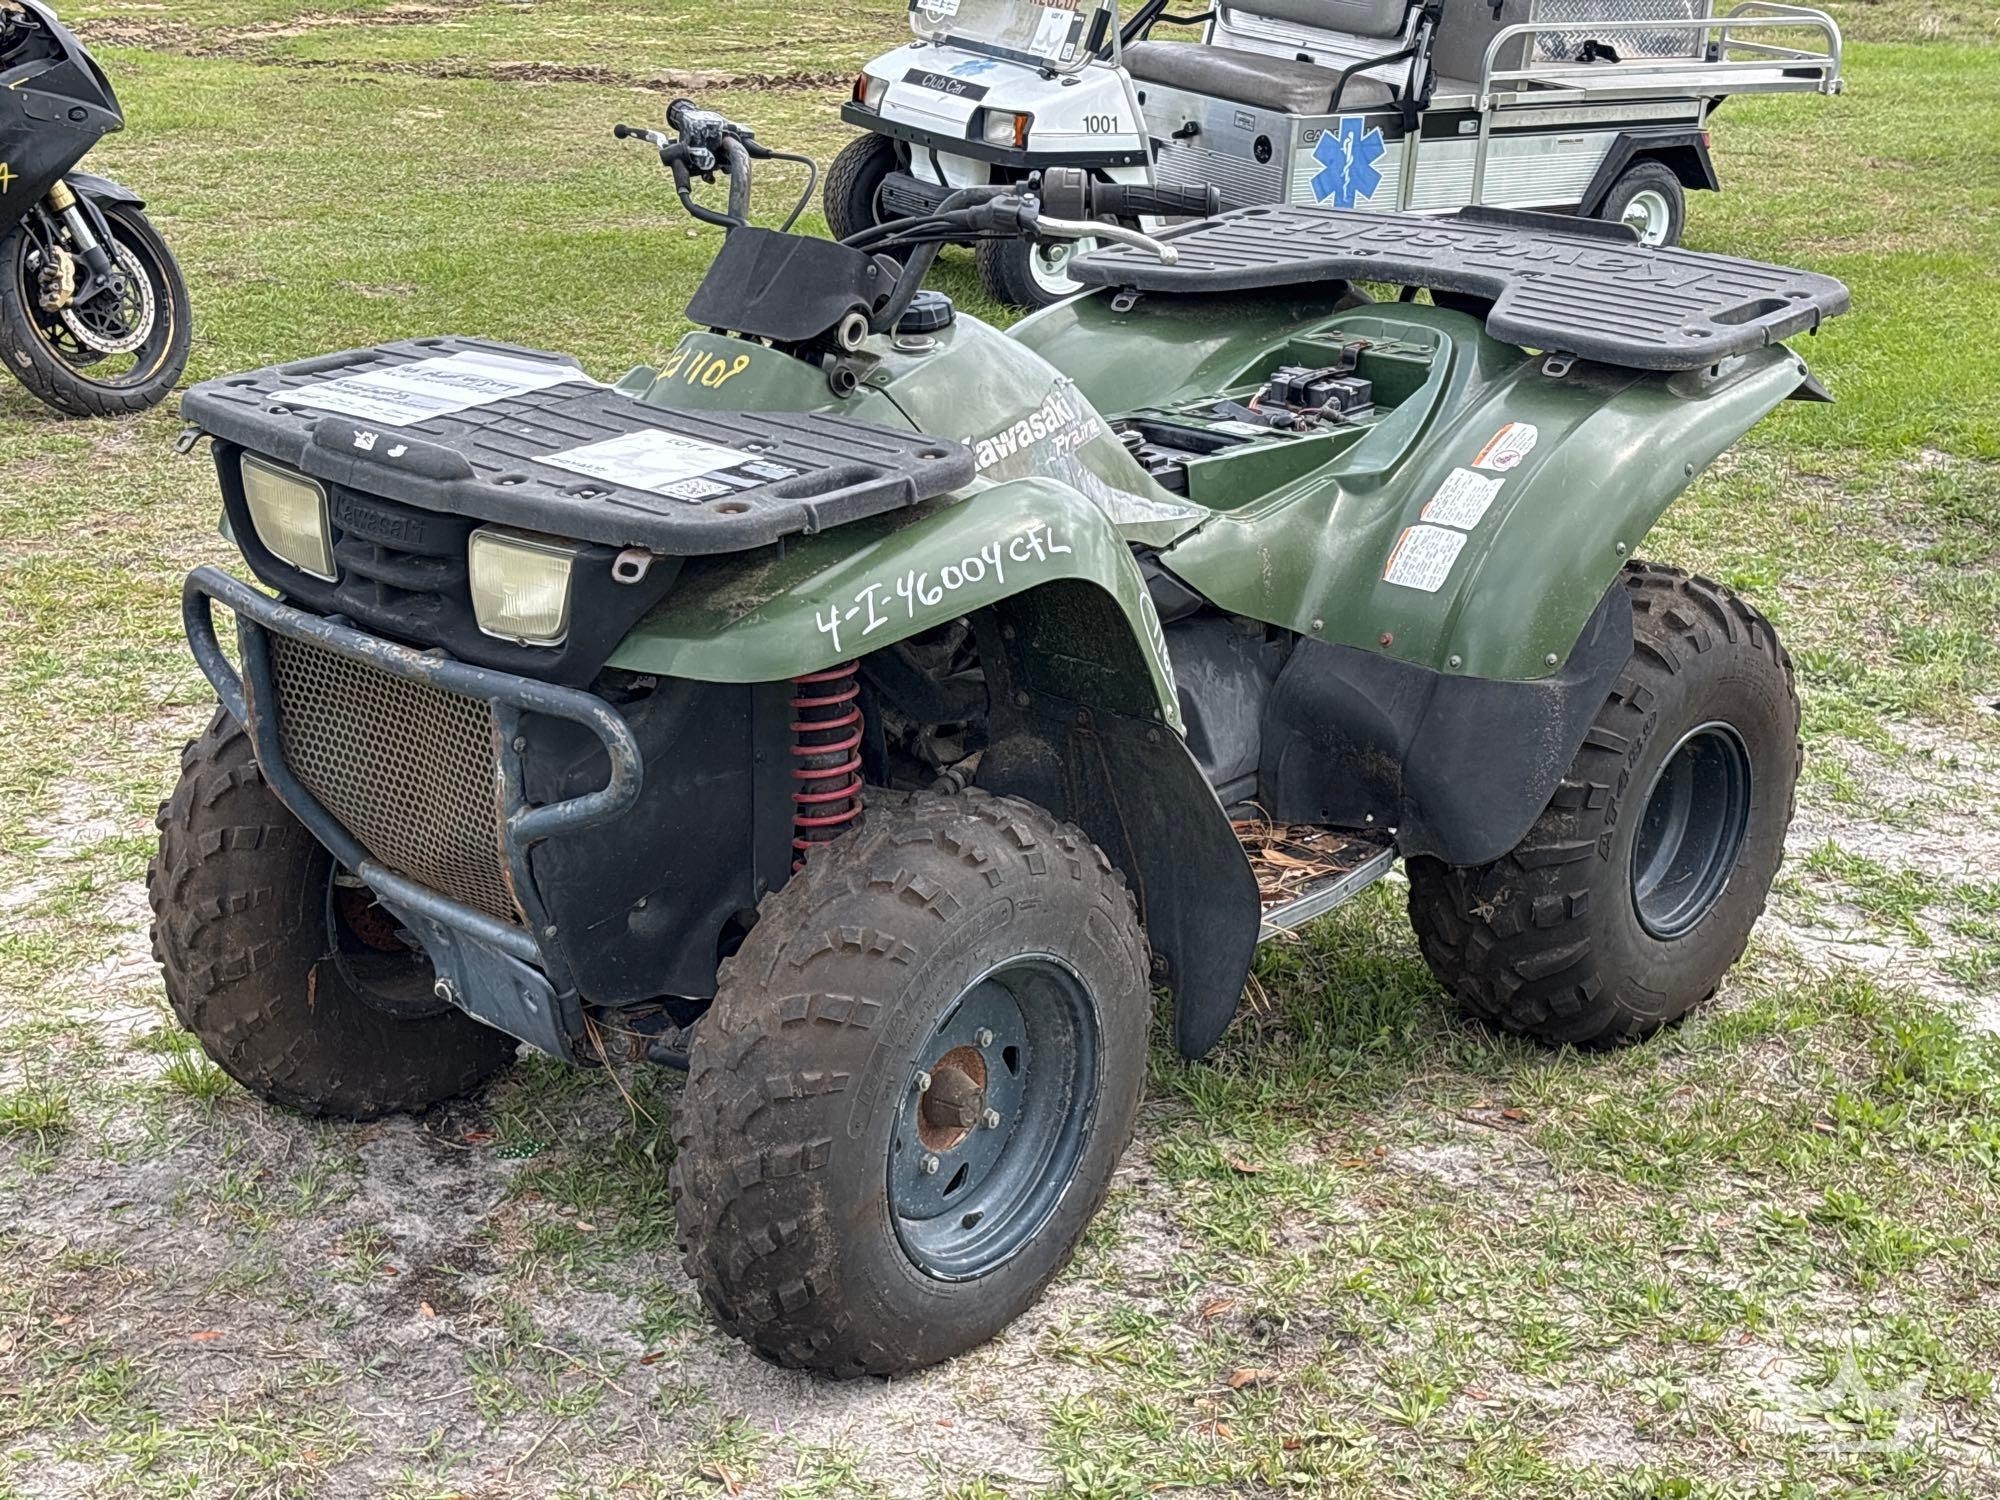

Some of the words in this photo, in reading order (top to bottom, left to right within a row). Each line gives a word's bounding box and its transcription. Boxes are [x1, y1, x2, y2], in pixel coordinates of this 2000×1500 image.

[922, 74, 946, 90] Club
[946, 80, 966, 95] Car
[1082, 115, 1118, 133] 1001
[1274, 219, 1714, 289] Kawasaki
[335, 496, 424, 544] Kawasaki
